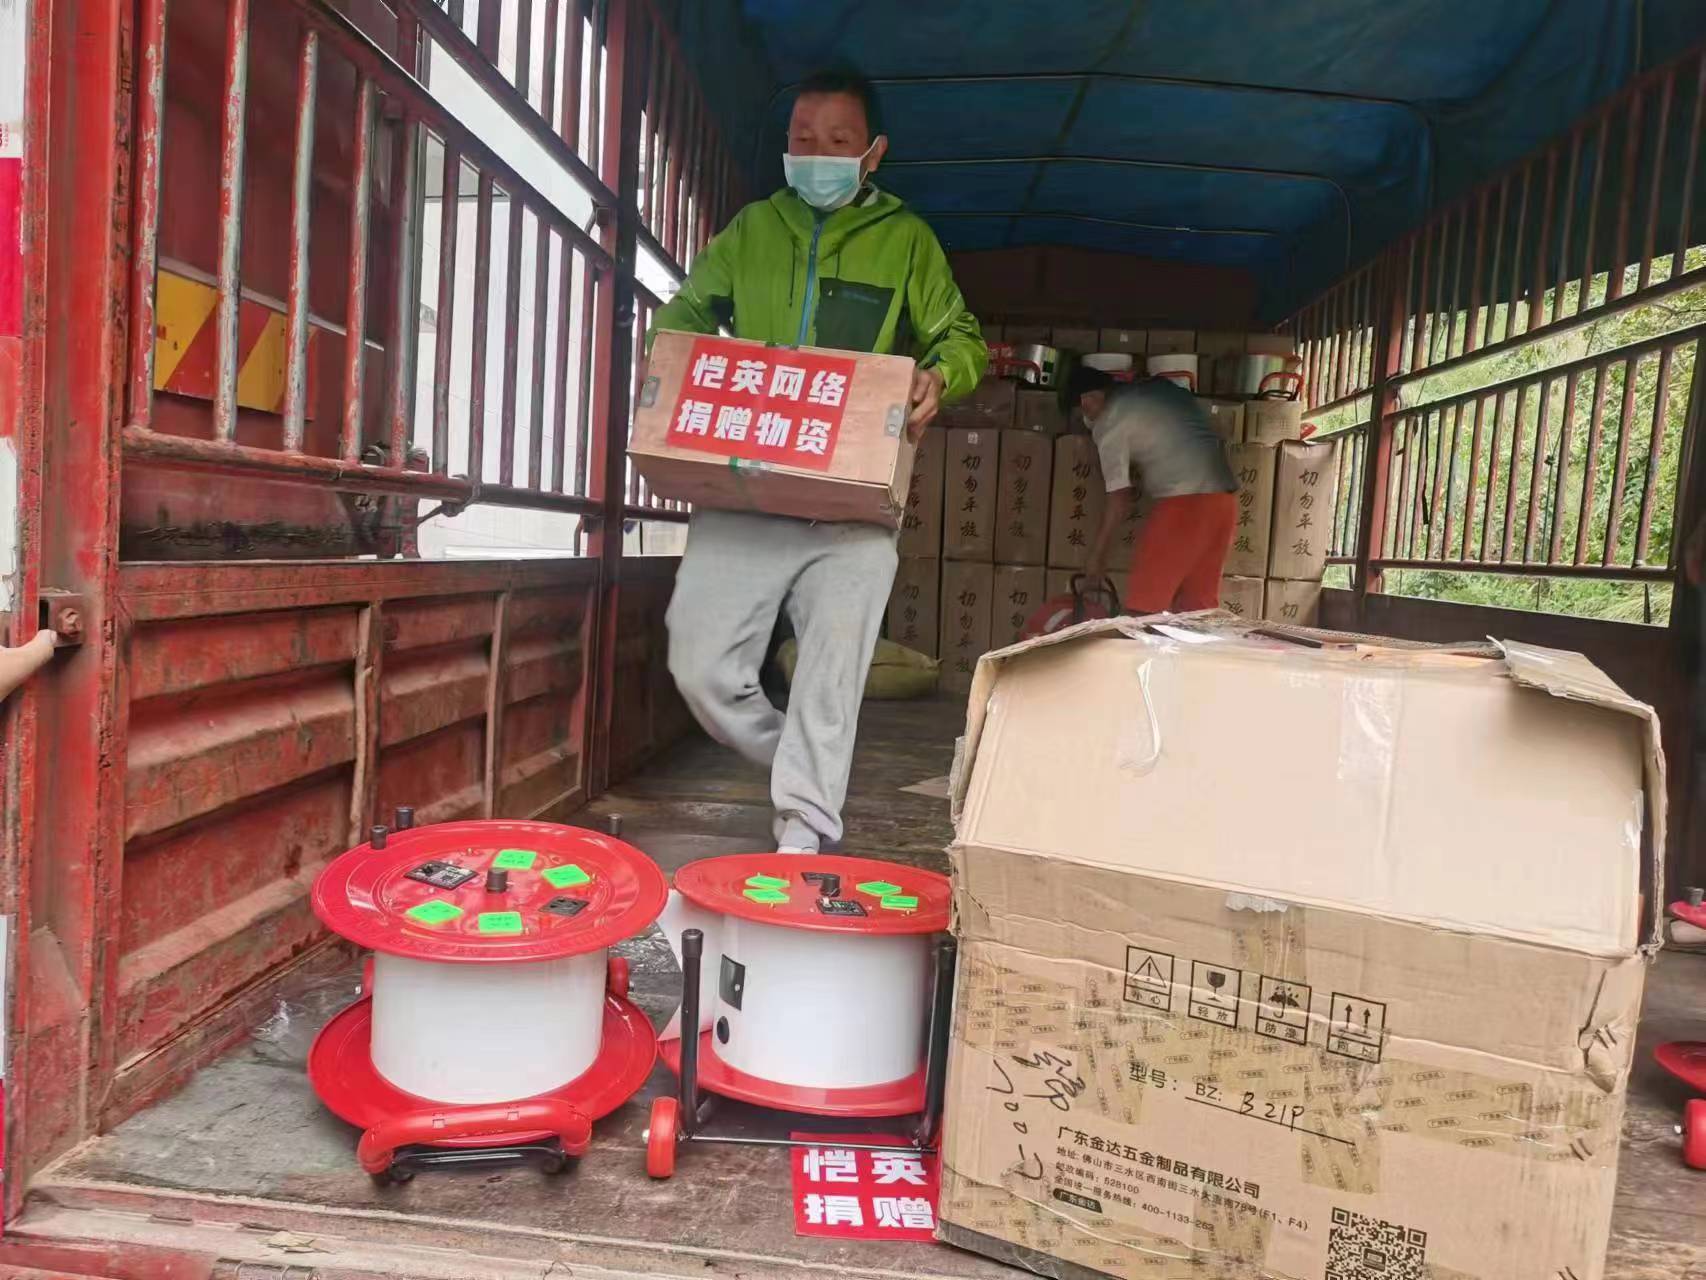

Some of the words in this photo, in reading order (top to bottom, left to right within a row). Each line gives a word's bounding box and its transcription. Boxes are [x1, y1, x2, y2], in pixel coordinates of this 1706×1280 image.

[691, 353, 848, 407] 恺英网络
[675, 399, 833, 456] 捐赠物资
[960, 455, 981, 538] 切勿平放
[1008, 455, 1033, 539] 切勿平放
[1066, 462, 1091, 547] 切勿平放
[1234, 466, 1257, 554] 切勿平放
[1292, 468, 1319, 557] 切勿平放
[1197, 1006, 1229, 1023] 轻放
[1129, 1062, 1178, 1091] 型号：
[803, 1149, 929, 1186] 恺英
[1058, 1126, 1260, 1199] 广东金达五金制品有限公司
[803, 1193, 935, 1230] 捐赠
